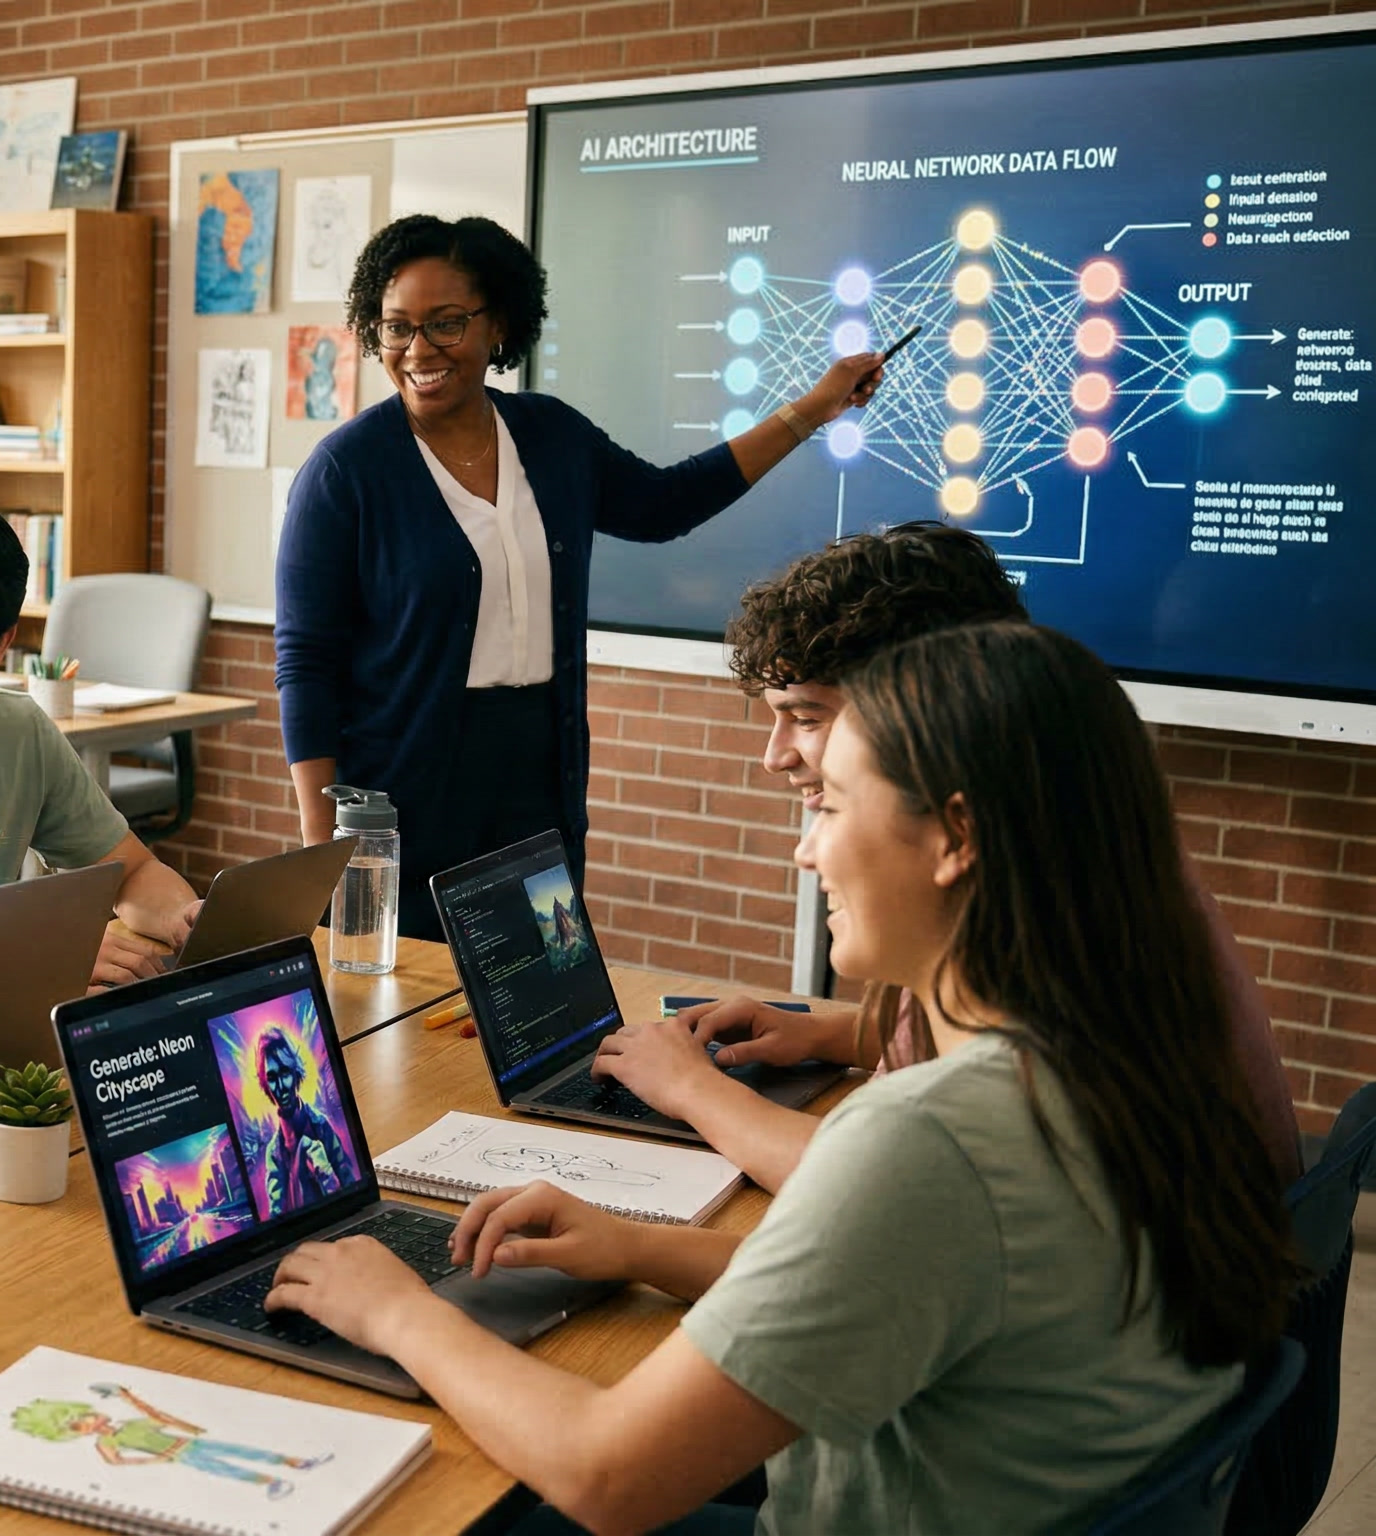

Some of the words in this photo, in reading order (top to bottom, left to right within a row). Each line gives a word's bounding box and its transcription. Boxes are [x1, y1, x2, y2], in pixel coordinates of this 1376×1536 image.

[580, 137, 600, 162] AI
[605, 126, 757, 160] ARCHITECTURE
[842, 160, 910, 182] NEURAL
[914, 153, 1005, 178] NETWORK
[1008, 151, 1057, 173] DATA
[1063, 147, 1117, 170] FLOW
[728, 225, 770, 243] INPUT
[1178, 283, 1252, 302] OUTPUT
[1298, 327, 1354, 341] Generate:
[90, 1045, 159, 1079] Generate:
[159, 1034, 195, 1058] Neon
[96, 1069, 165, 1102] Cityscape
